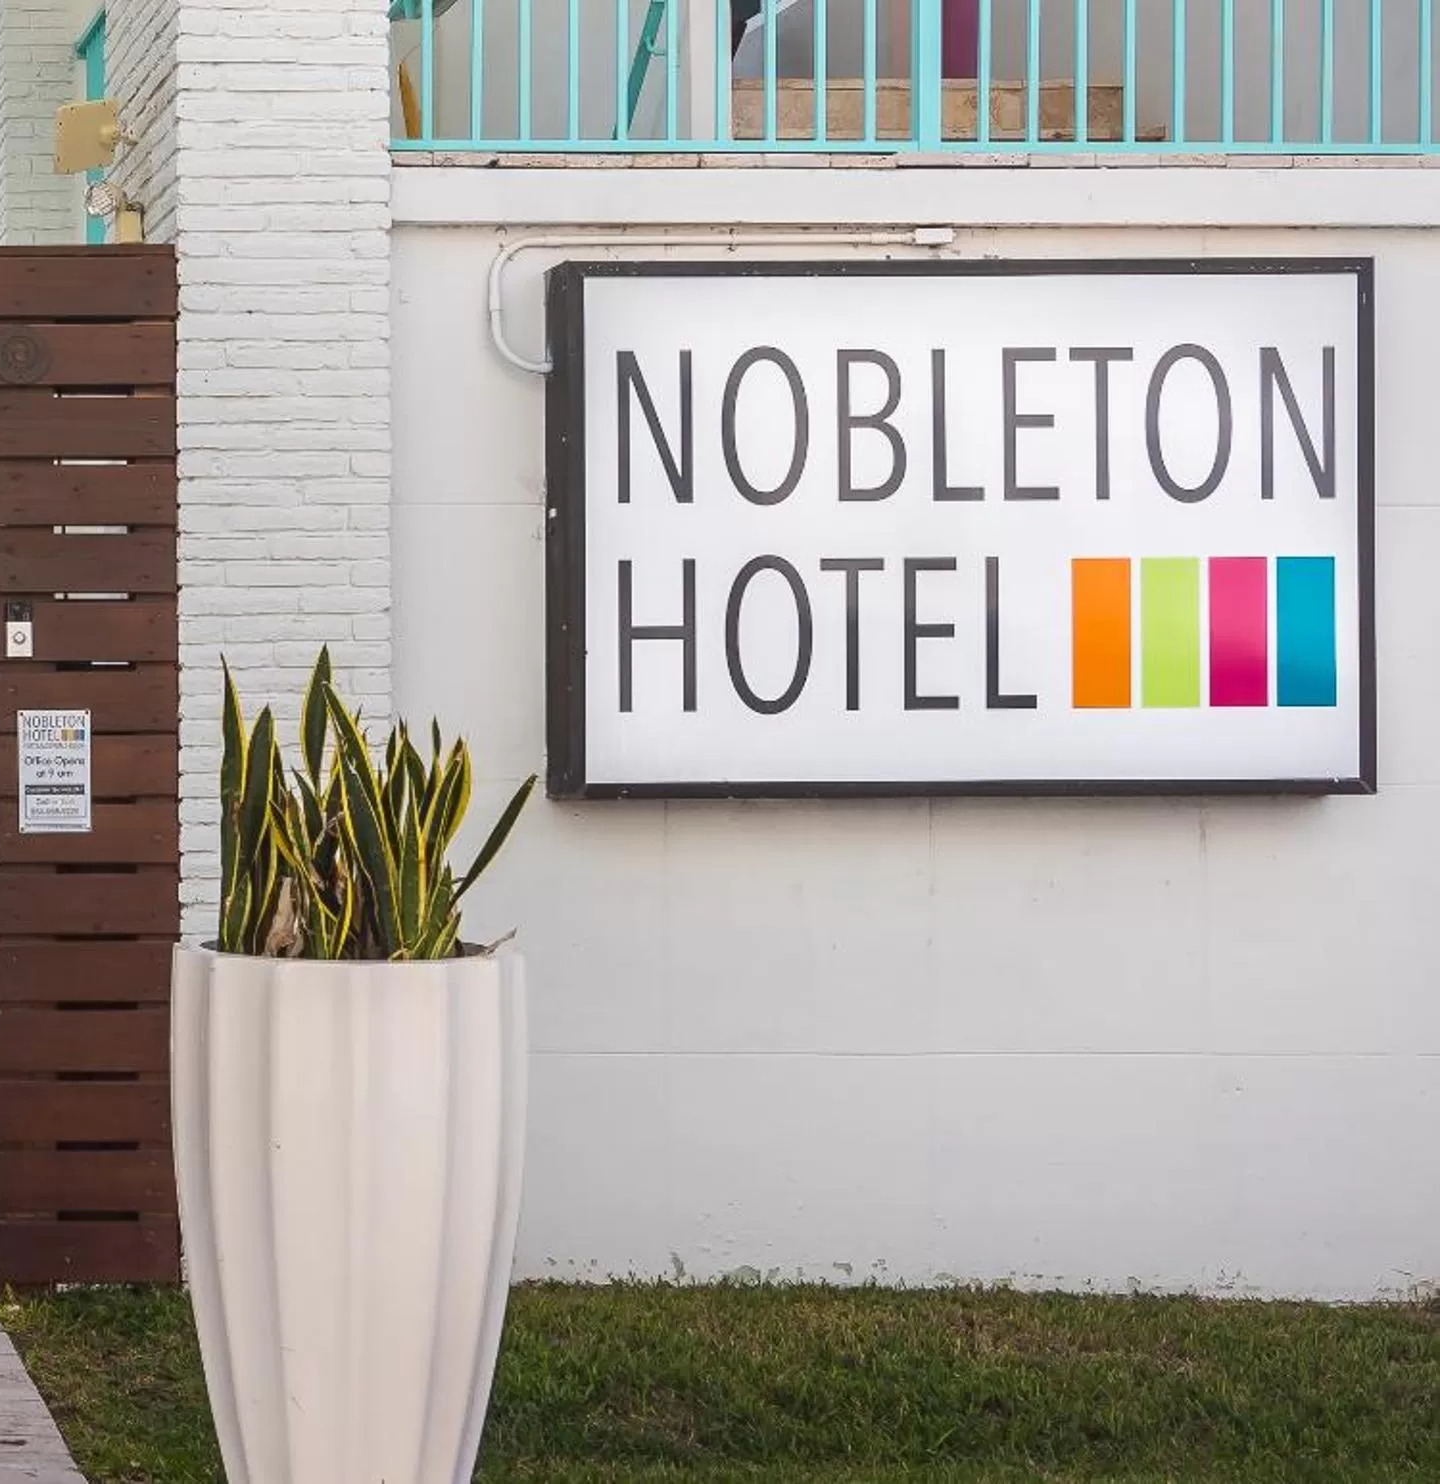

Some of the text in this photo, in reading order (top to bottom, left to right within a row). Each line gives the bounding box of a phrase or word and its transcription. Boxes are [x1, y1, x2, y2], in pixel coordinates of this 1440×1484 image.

[616, 342, 1336, 506] NOBLETON
[617, 553, 1038, 715] HOTEL
[23, 715, 85, 728] NOBLETON
[23, 729, 60, 741] HOTEL
